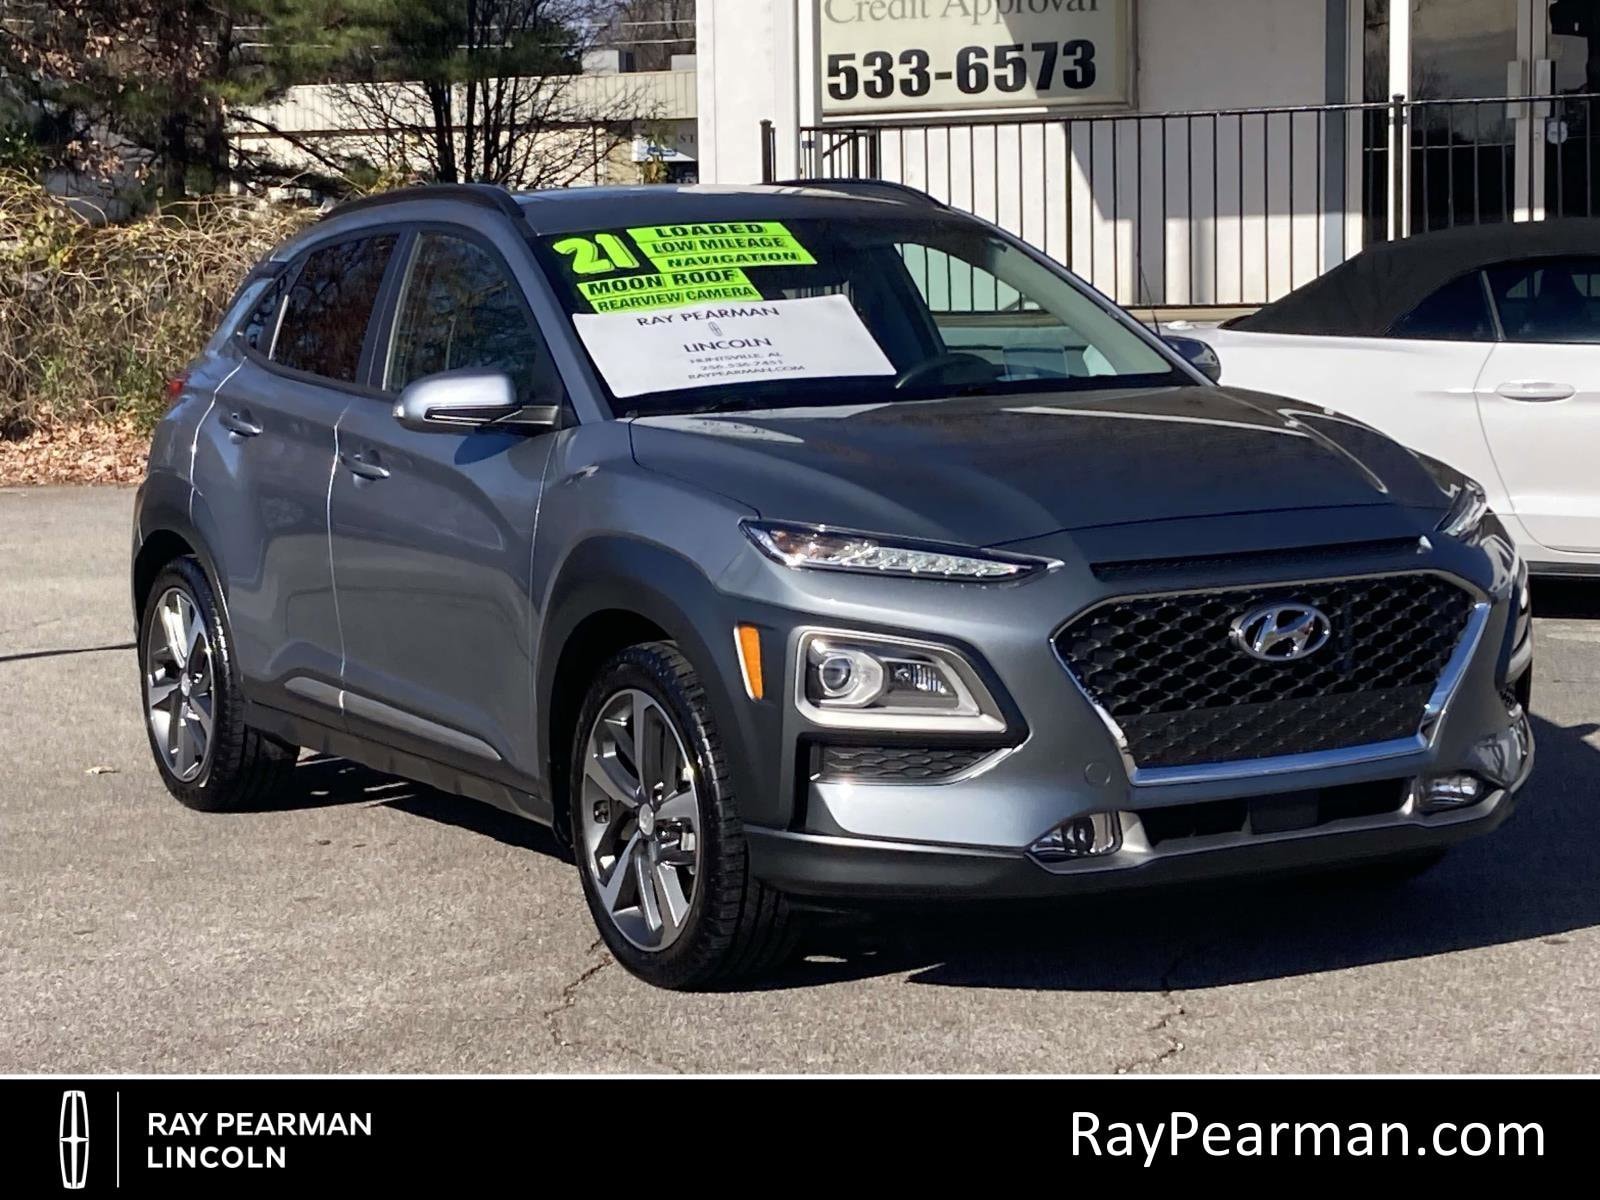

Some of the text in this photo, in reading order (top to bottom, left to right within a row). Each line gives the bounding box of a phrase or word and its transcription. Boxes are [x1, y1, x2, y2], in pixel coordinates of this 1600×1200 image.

[824, 0, 929, 24] Credit
[827, 39, 1097, 101] 533-6573
[655, 223, 764, 238] LOADED
[552, 233, 641, 275] 21
[652, 236, 785, 254] LOW MILEAGE
[666, 251, 799, 268] NAVIGATION
[588, 269, 738, 295] MOON ROOF
[597, 286, 754, 312] REARVIEW CAMERA
[636, 306, 780, 327] RAY PEARMAN
[683, 337, 773, 353] LINCOLN
